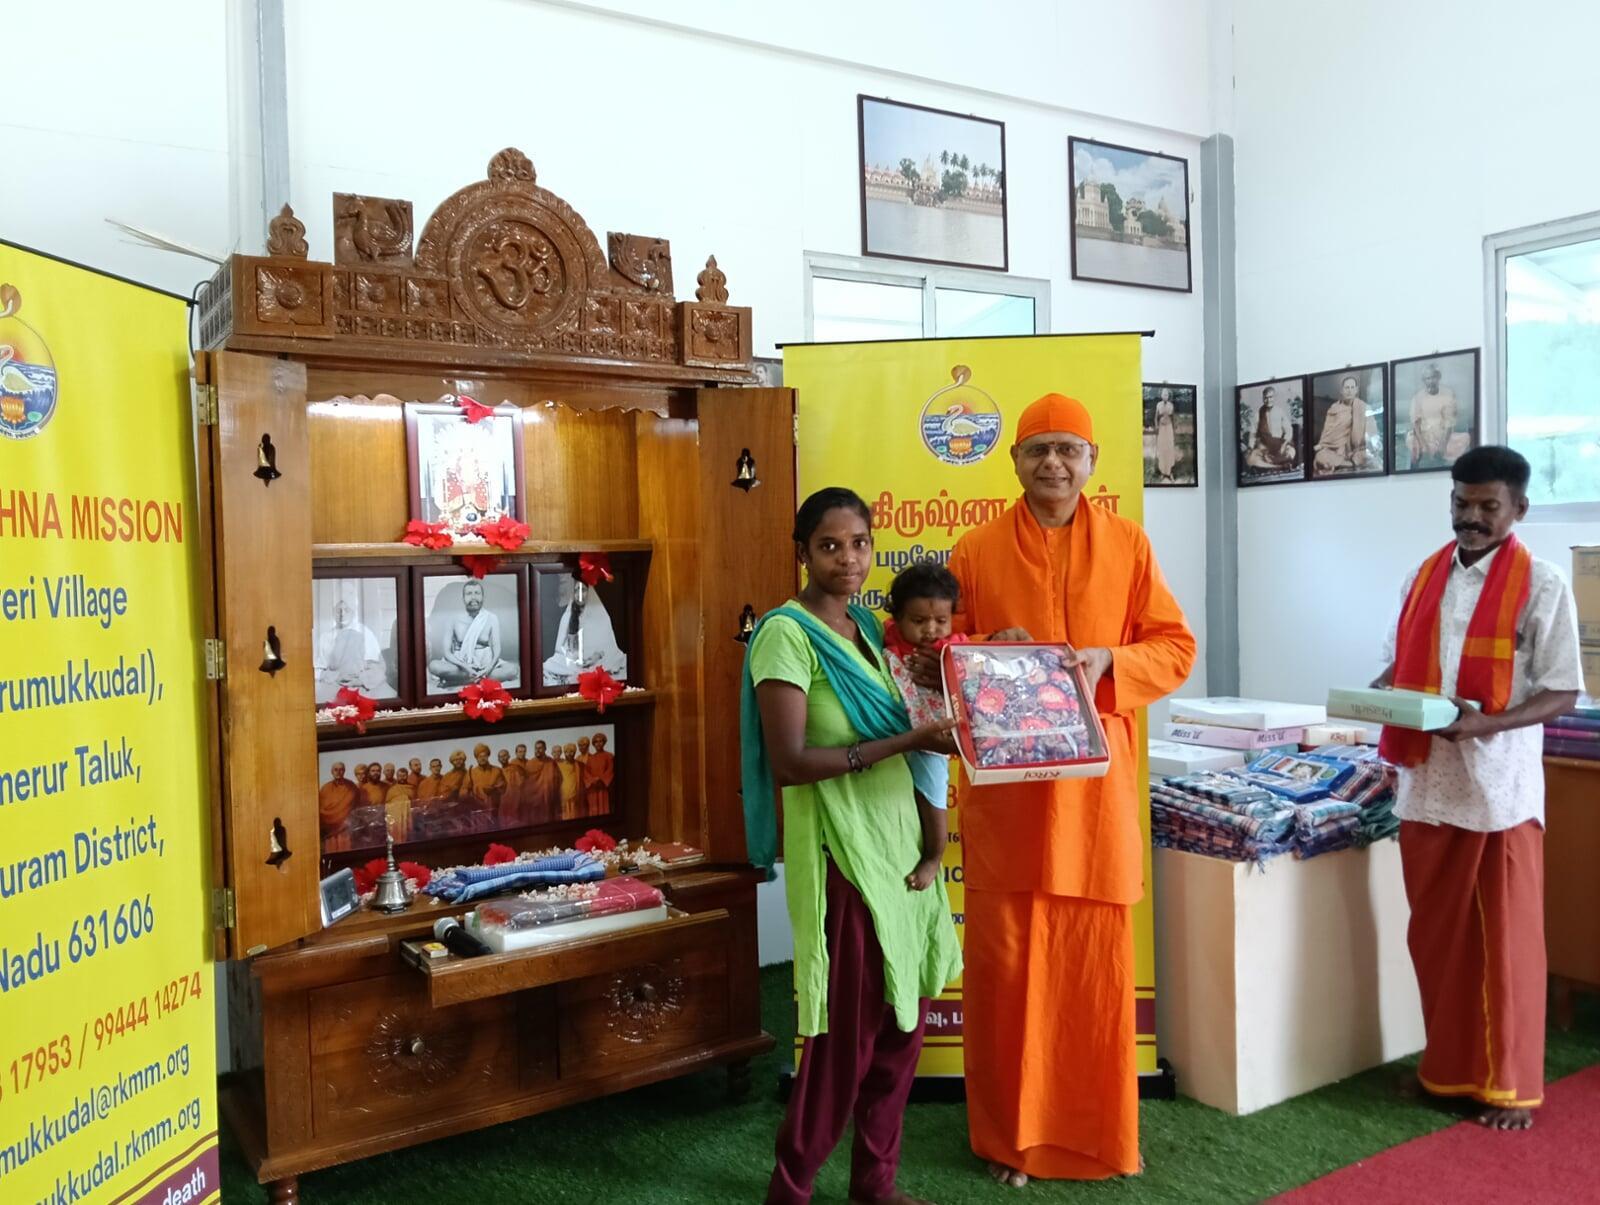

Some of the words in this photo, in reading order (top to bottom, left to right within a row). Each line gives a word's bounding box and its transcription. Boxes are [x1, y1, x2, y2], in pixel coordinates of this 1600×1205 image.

[72, 494, 183, 543] MISSION
[0, 575, 36, 621] eri
[43, 573, 127, 629] Village
[0, 648, 163, 713] rumukkudal),
[74, 736, 141, 787] Taluk,
[0, 848, 67, 899] uram
[74, 814, 164, 874] District,
[69, 893, 154, 964] 631606
[10, 1034, 72, 1094] 17953
[94, 996, 149, 1051] 99444
[154, 970, 202, 1019] 14274
[162, 1167, 206, 1205] death
